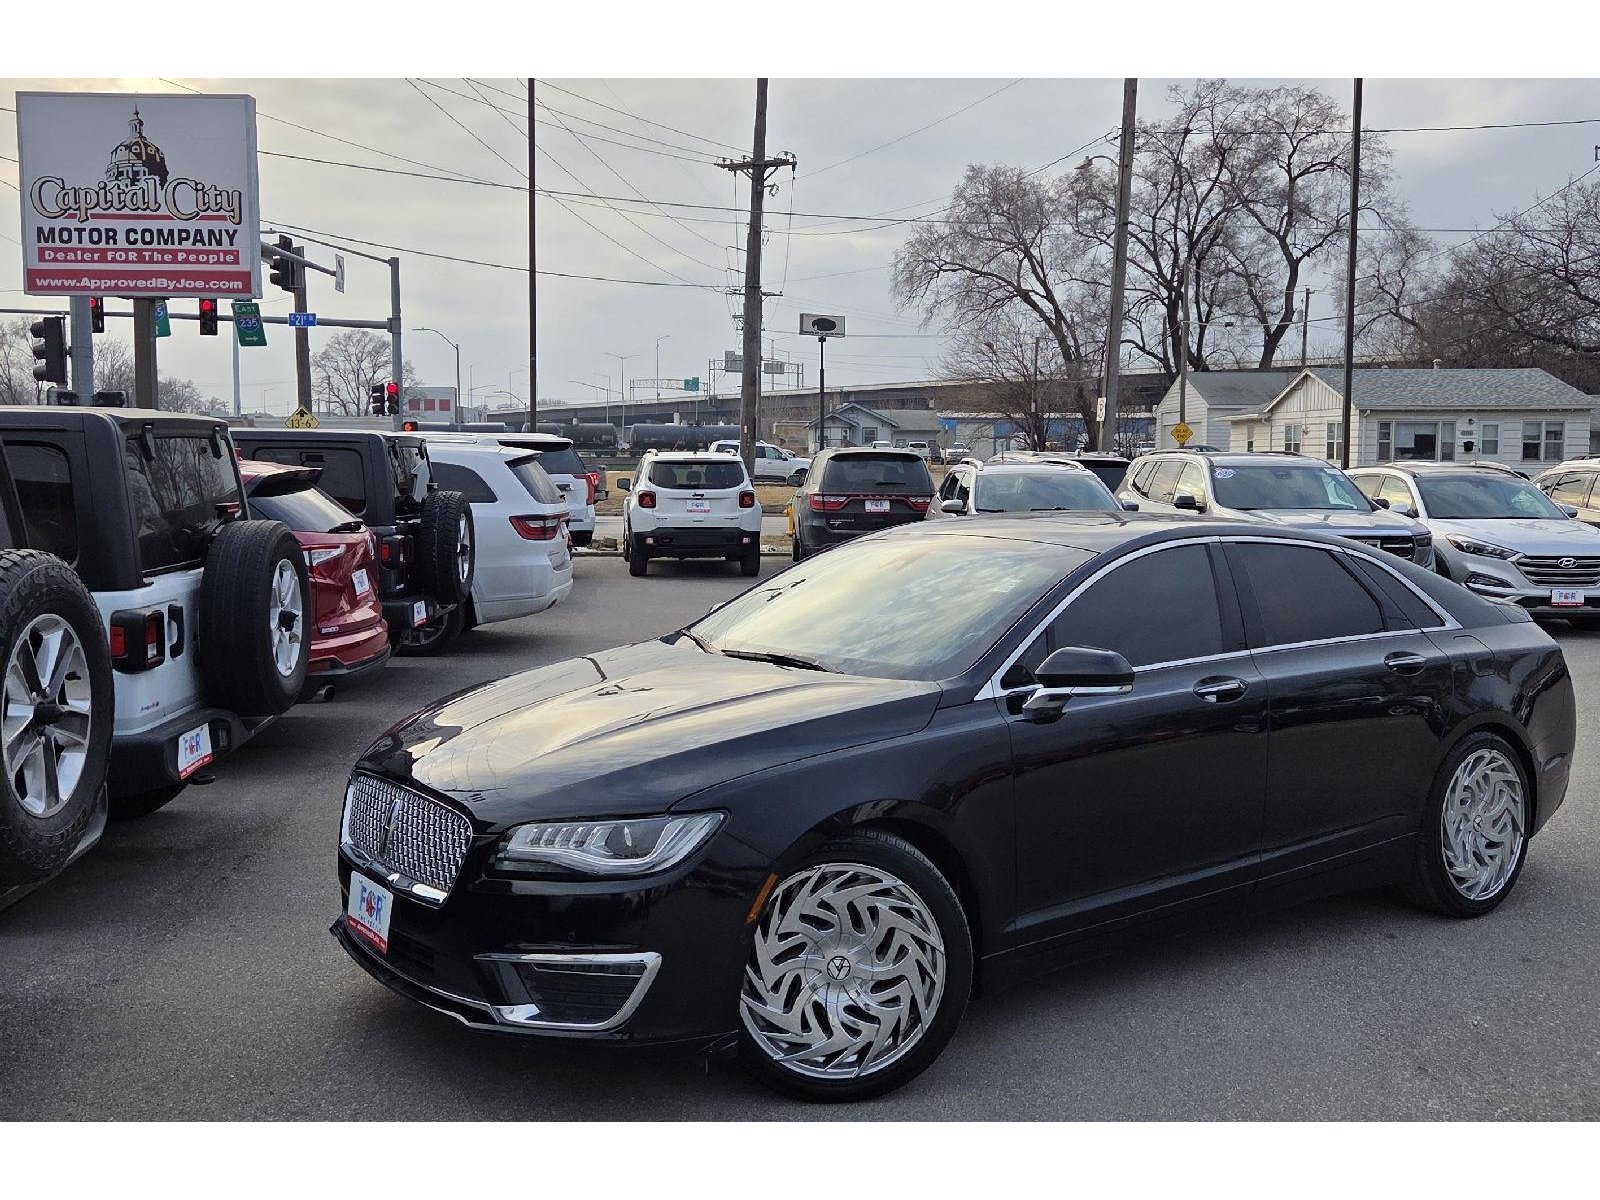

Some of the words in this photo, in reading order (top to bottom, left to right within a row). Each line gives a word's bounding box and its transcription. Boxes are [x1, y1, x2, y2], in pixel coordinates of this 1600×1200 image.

[31, 175, 161, 223] Capital
[165, 177, 242, 225] City
[37, 226, 118, 246] MOTOR
[125, 228, 238, 247] COMPANY
[45, 250, 100, 261] Dealer
[107, 251, 138, 261] FOR
[143, 251, 172, 262] The
[177, 252, 234, 264] People
[36, 277, 243, 290] www.ApprovedByJoe.com
[239, 318, 258, 328] 235
